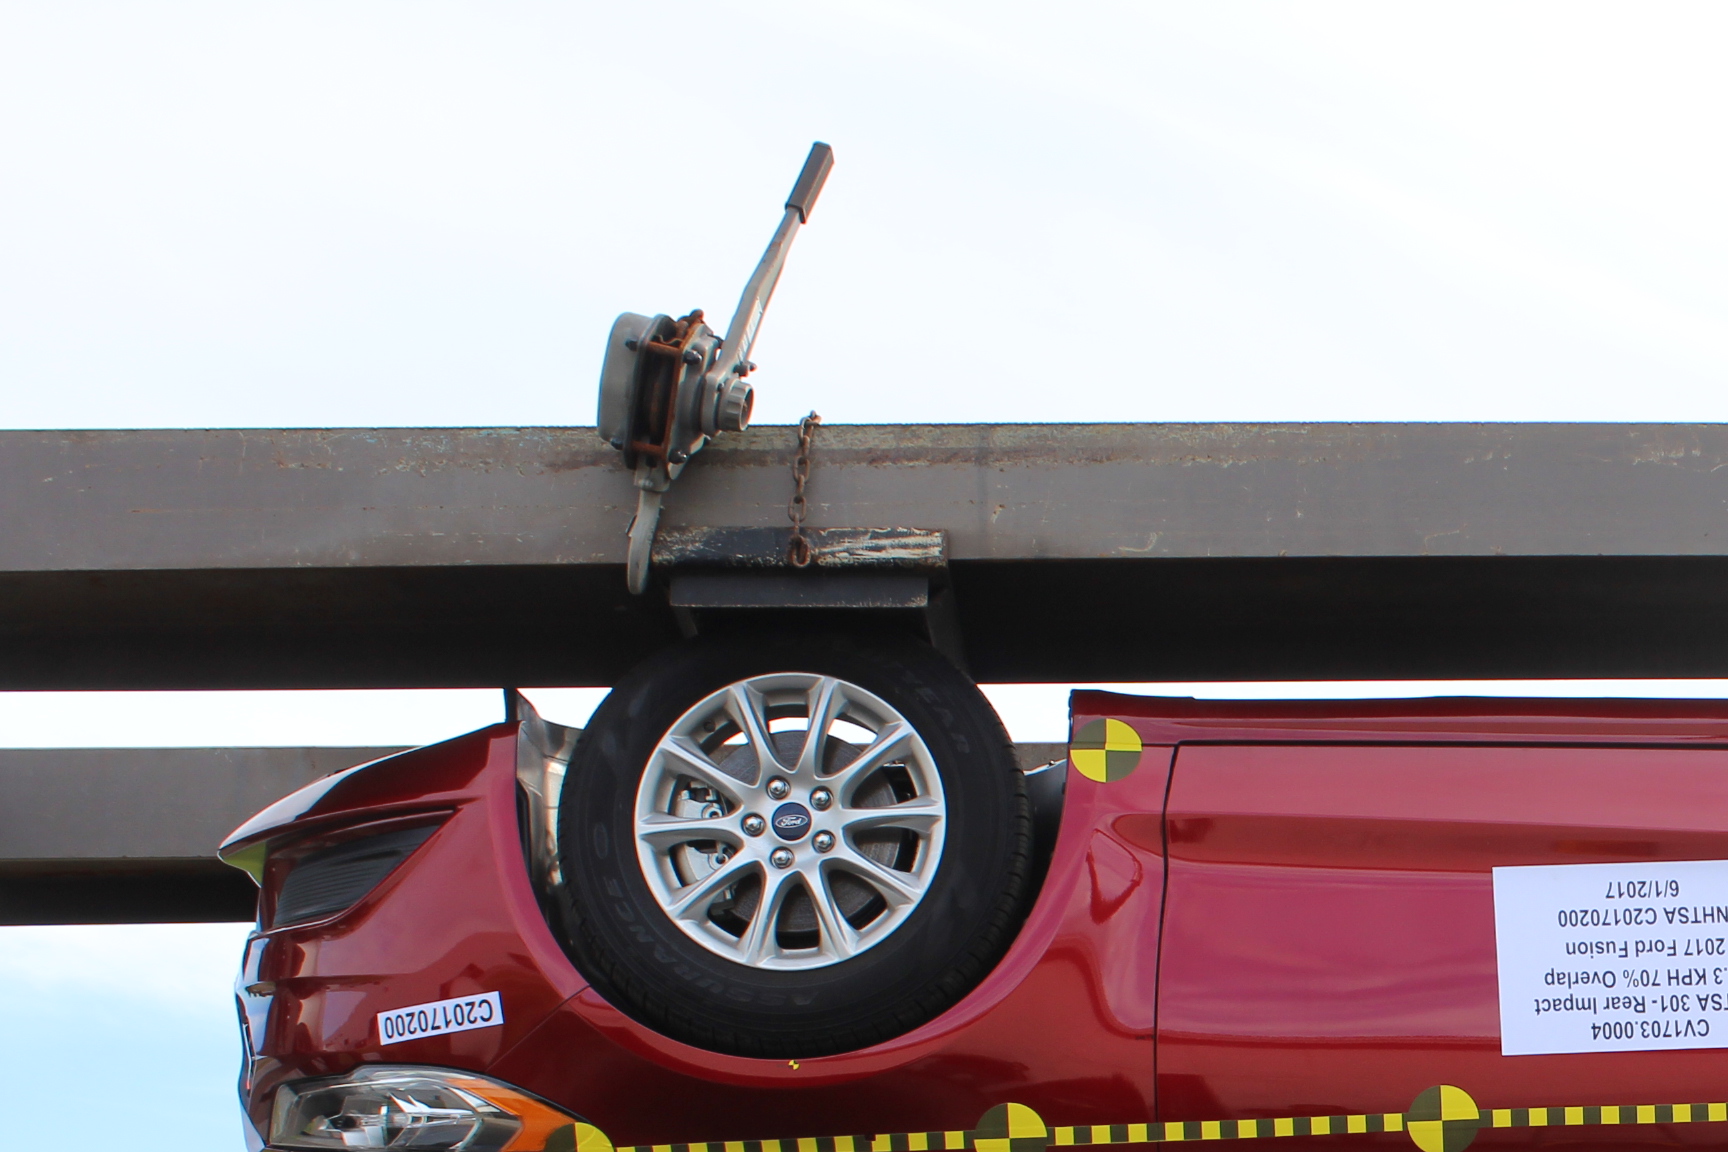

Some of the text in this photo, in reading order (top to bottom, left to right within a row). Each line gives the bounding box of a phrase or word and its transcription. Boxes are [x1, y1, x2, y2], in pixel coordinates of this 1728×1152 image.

[780, 816, 803, 827] Ford
[1606, 880, 1679, 898] 6/1/2017
[1558, 906, 1728, 927] NHTSA C20170200
[1566, 938, 1725, 958] 2017 Ford Fusion
[1544, 967, 1616, 989] Overlap
[1623, 969, 1661, 987] 70%
[1667, 968, 1706, 986] KPH
[1534, 994, 1597, 1015] Impact
[1604, 995, 1646, 1014] Rear
[1652, 994, 1690, 1012] 301-
[384, 999, 494, 1039] C20170200
[1591, 1019, 1710, 1040] CV1703.0004
